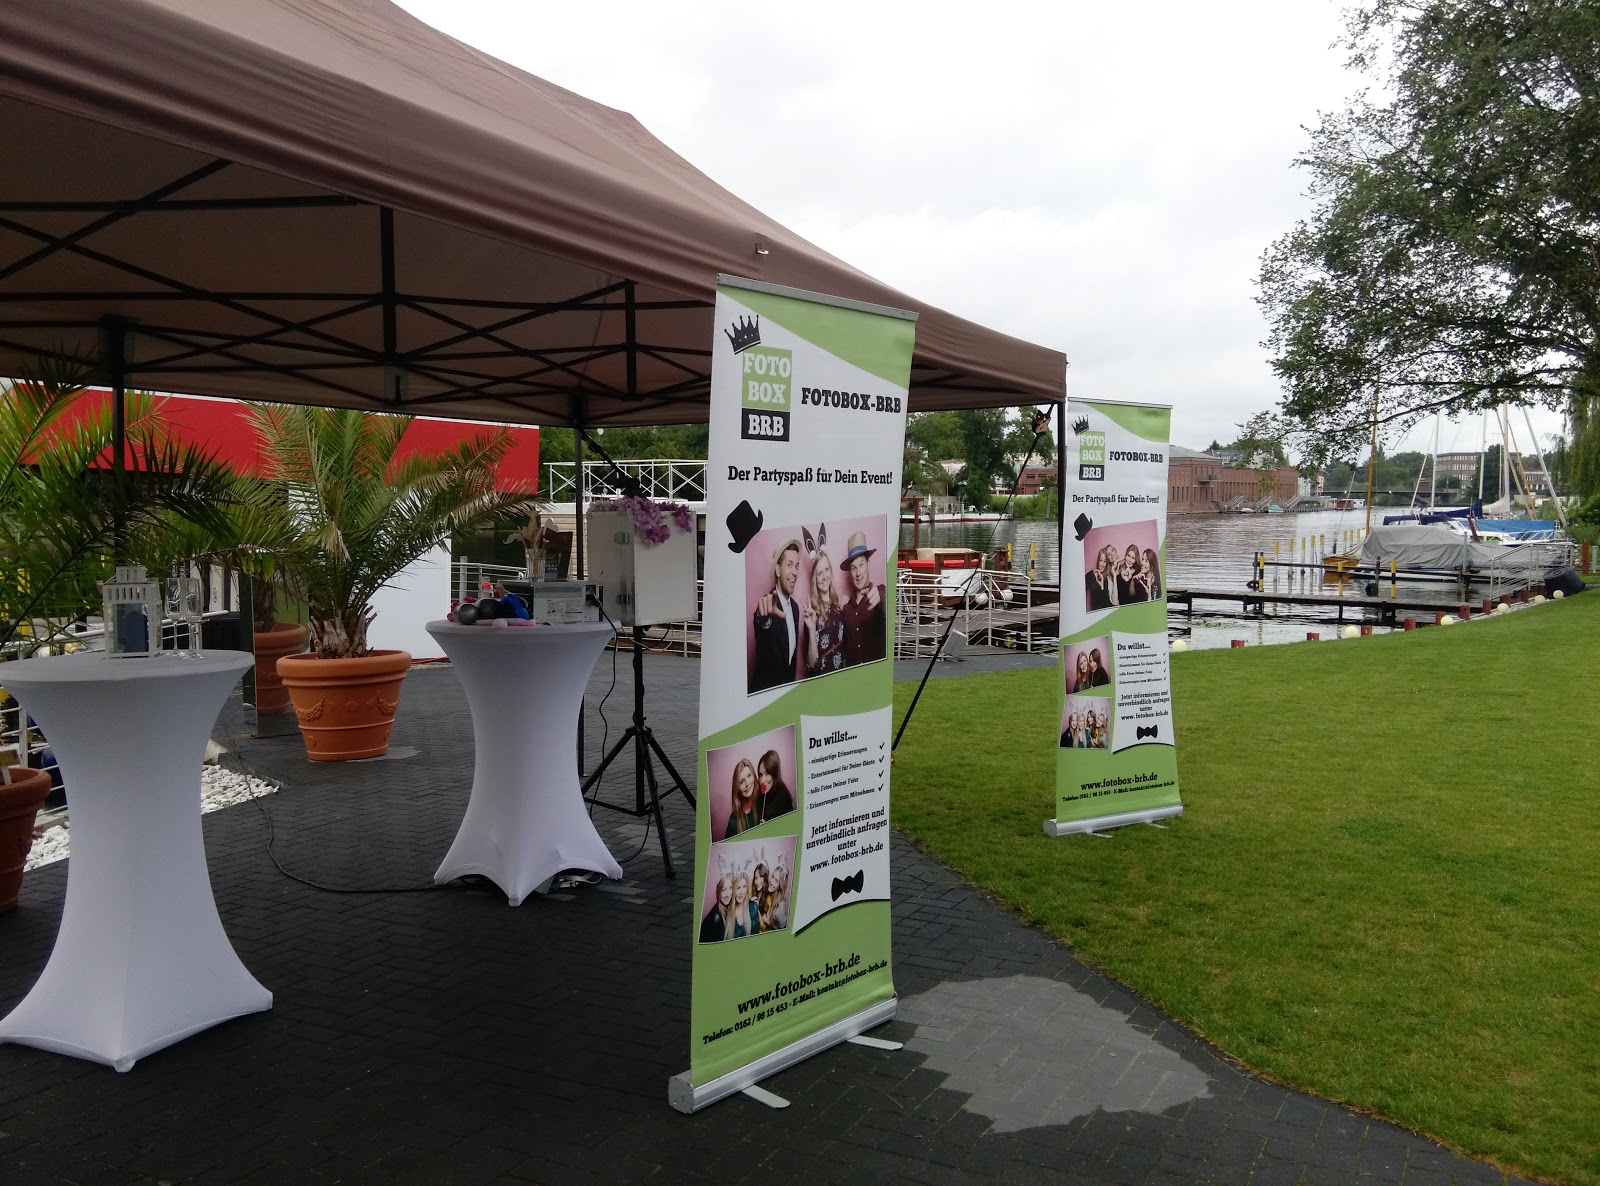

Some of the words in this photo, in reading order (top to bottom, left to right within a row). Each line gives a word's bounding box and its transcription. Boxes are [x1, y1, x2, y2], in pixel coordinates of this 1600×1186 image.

[743, 352, 791, 378] FOTO
[747, 380, 786, 404] BOX
[801, 387, 902, 414] FOTOBOX-BRB
[748, 414, 784, 437] BRB
[1080, 435, 1105, 447] FOTO
[1082, 449, 1102, 461] BOX
[1109, 451, 1163, 463] FOTOBOX-BRB
[727, 465, 751, 482] Der
[753, 466, 813, 486] Partyspaß
[816, 468, 833, 483] für
[835, 469, 858, 484] Dein
[860, 470, 893, 485] Event!
[1082, 466, 1102, 478] BRB
[1072, 494, 1085, 503] Der
[1117, 494, 1128, 503] für
[1129, 495, 1146, 503] Dein
[808, 737, 822, 749] Du
[811, 823, 828, 838] Jetzt
[828, 812, 870, 831] informieren
[871, 806, 885, 818] und
[806, 826, 856, 849] unverbindlich
[857, 819, 888, 834] anfragen
[837, 839, 857, 851] unter
[809, 860, 830, 872] www.
[831, 841, 884, 865] fotobox-brb.de
[737, 952, 861, 1014] www.fotobox-brb.de
[734, 1017, 751, 1031] 0162
[766, 1007, 774, 1018] 15
[775, 1001, 788, 1014] 453
